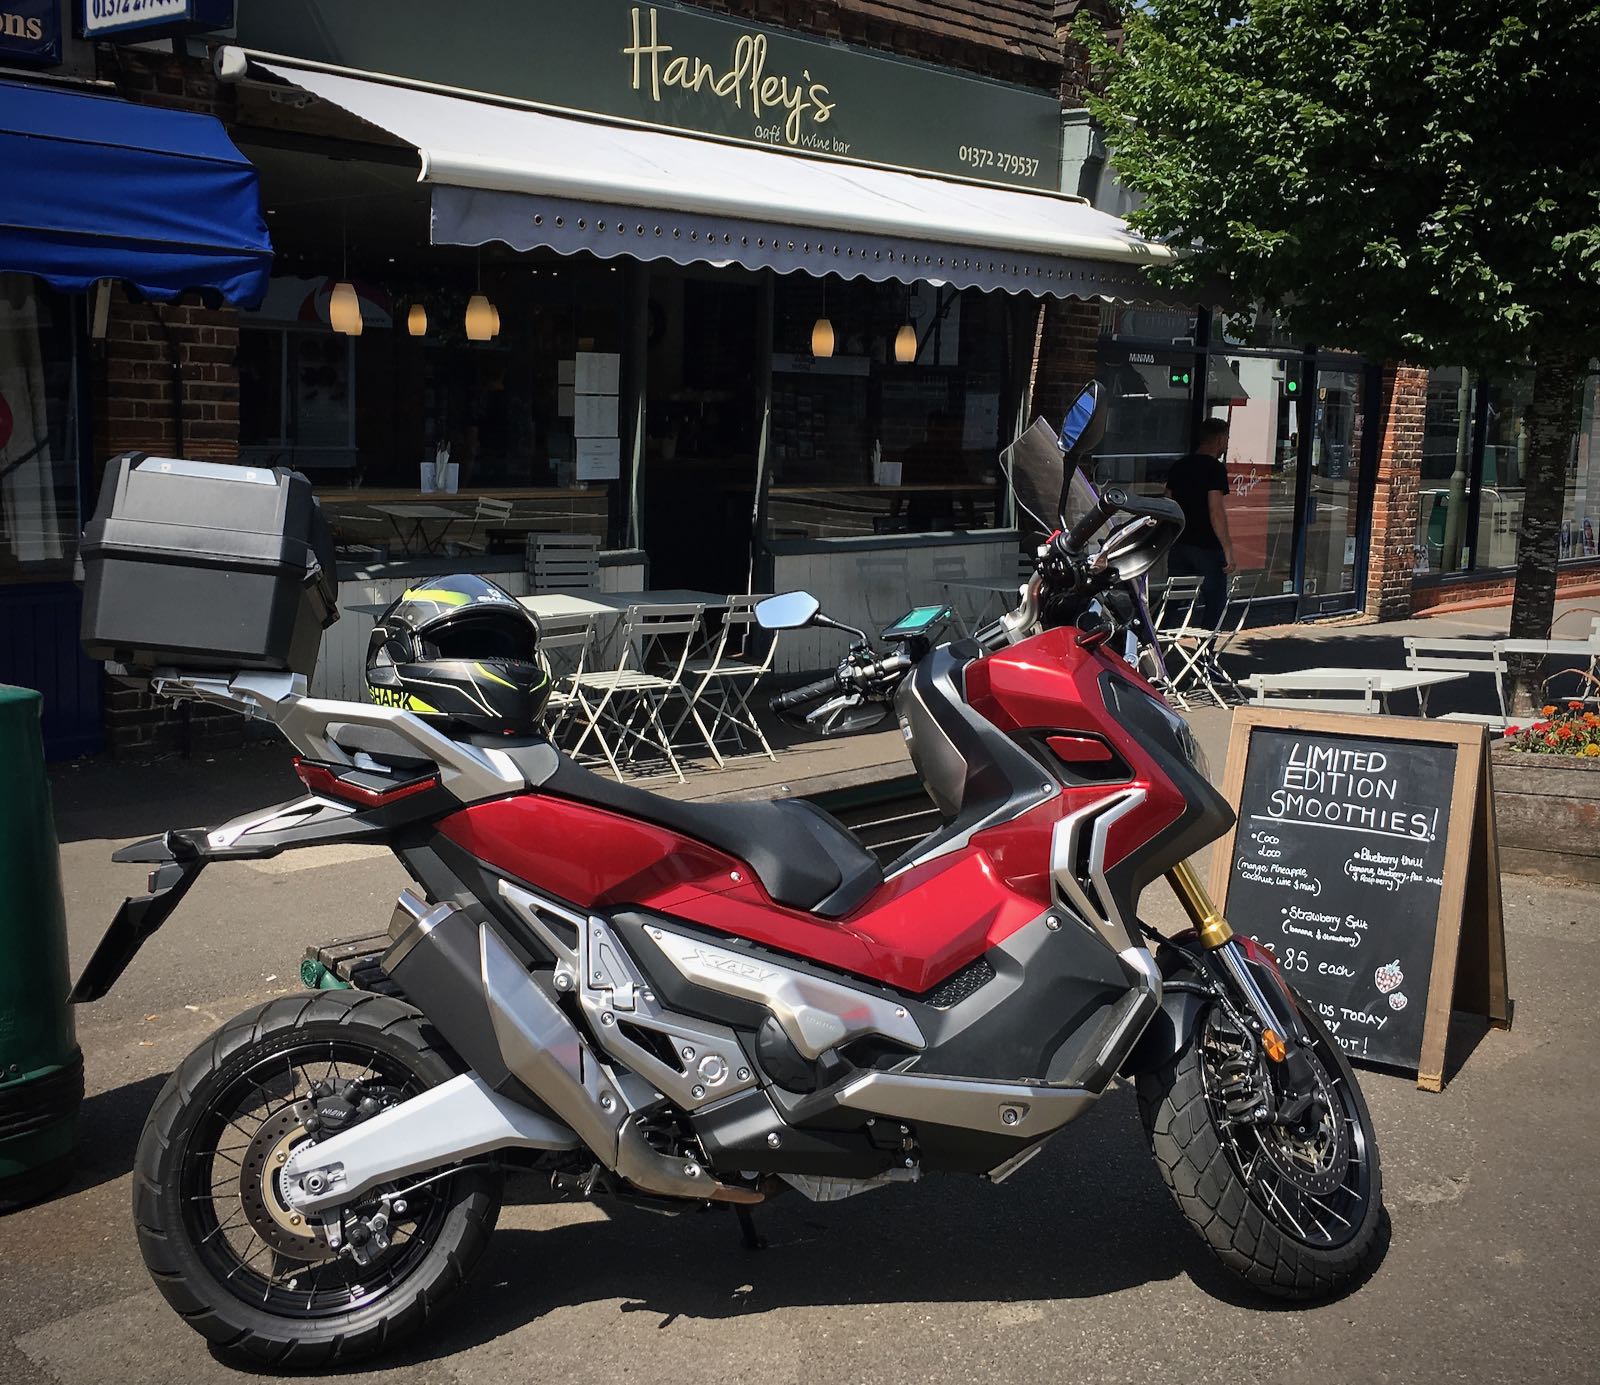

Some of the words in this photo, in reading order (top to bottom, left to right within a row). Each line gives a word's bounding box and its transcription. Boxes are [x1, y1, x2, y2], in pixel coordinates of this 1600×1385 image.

[623, 7, 836, 145] Handley's
[754, 124, 780, 145] Café
[801, 133, 830, 151] Wine
[832, 136, 850, 154] bar
[959, 145, 994, 168] 01372
[997, 152, 1039, 177] 279537
[1288, 742, 1387, 773] LIMITED
[1283, 766, 1397, 800] EDITION
[1289, 906, 1341, 931] Strawberry
[1318, 962, 1355, 977] each
[1319, 1003, 1335, 1017] US
[1340, 1007, 1388, 1030] TODAY
